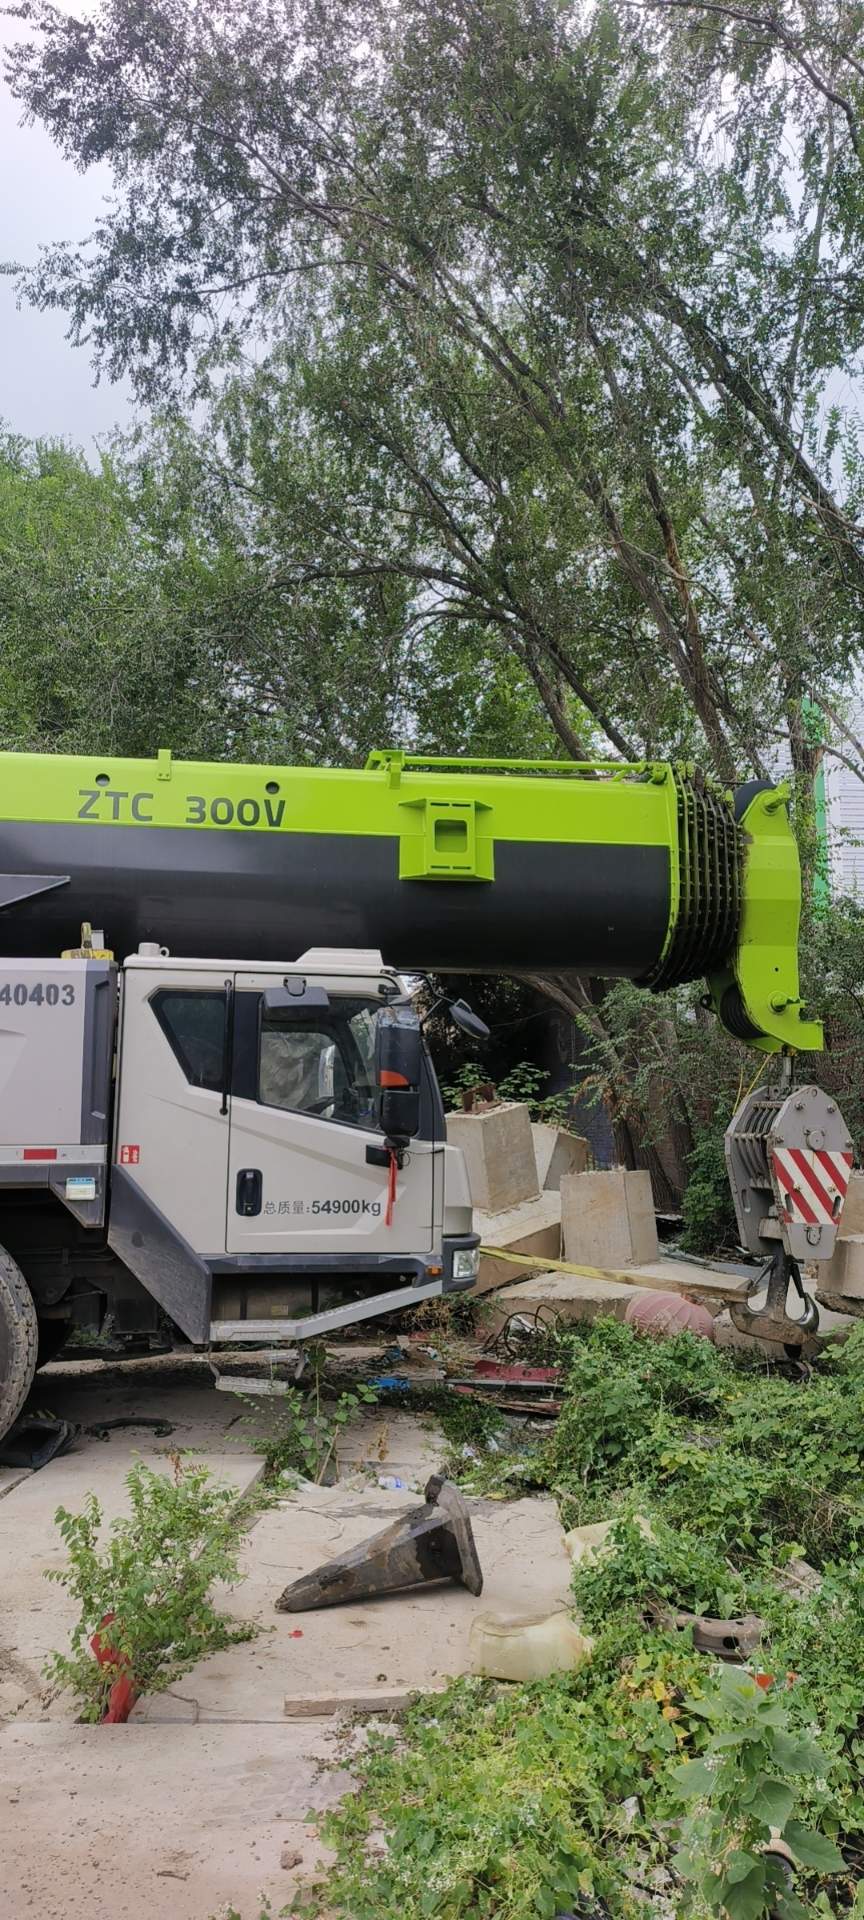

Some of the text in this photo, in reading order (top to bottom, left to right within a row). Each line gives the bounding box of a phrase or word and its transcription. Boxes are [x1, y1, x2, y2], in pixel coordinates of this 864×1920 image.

[77, 789, 286, 827] ZTC 300V
[0, 983, 76, 1006] 40403
